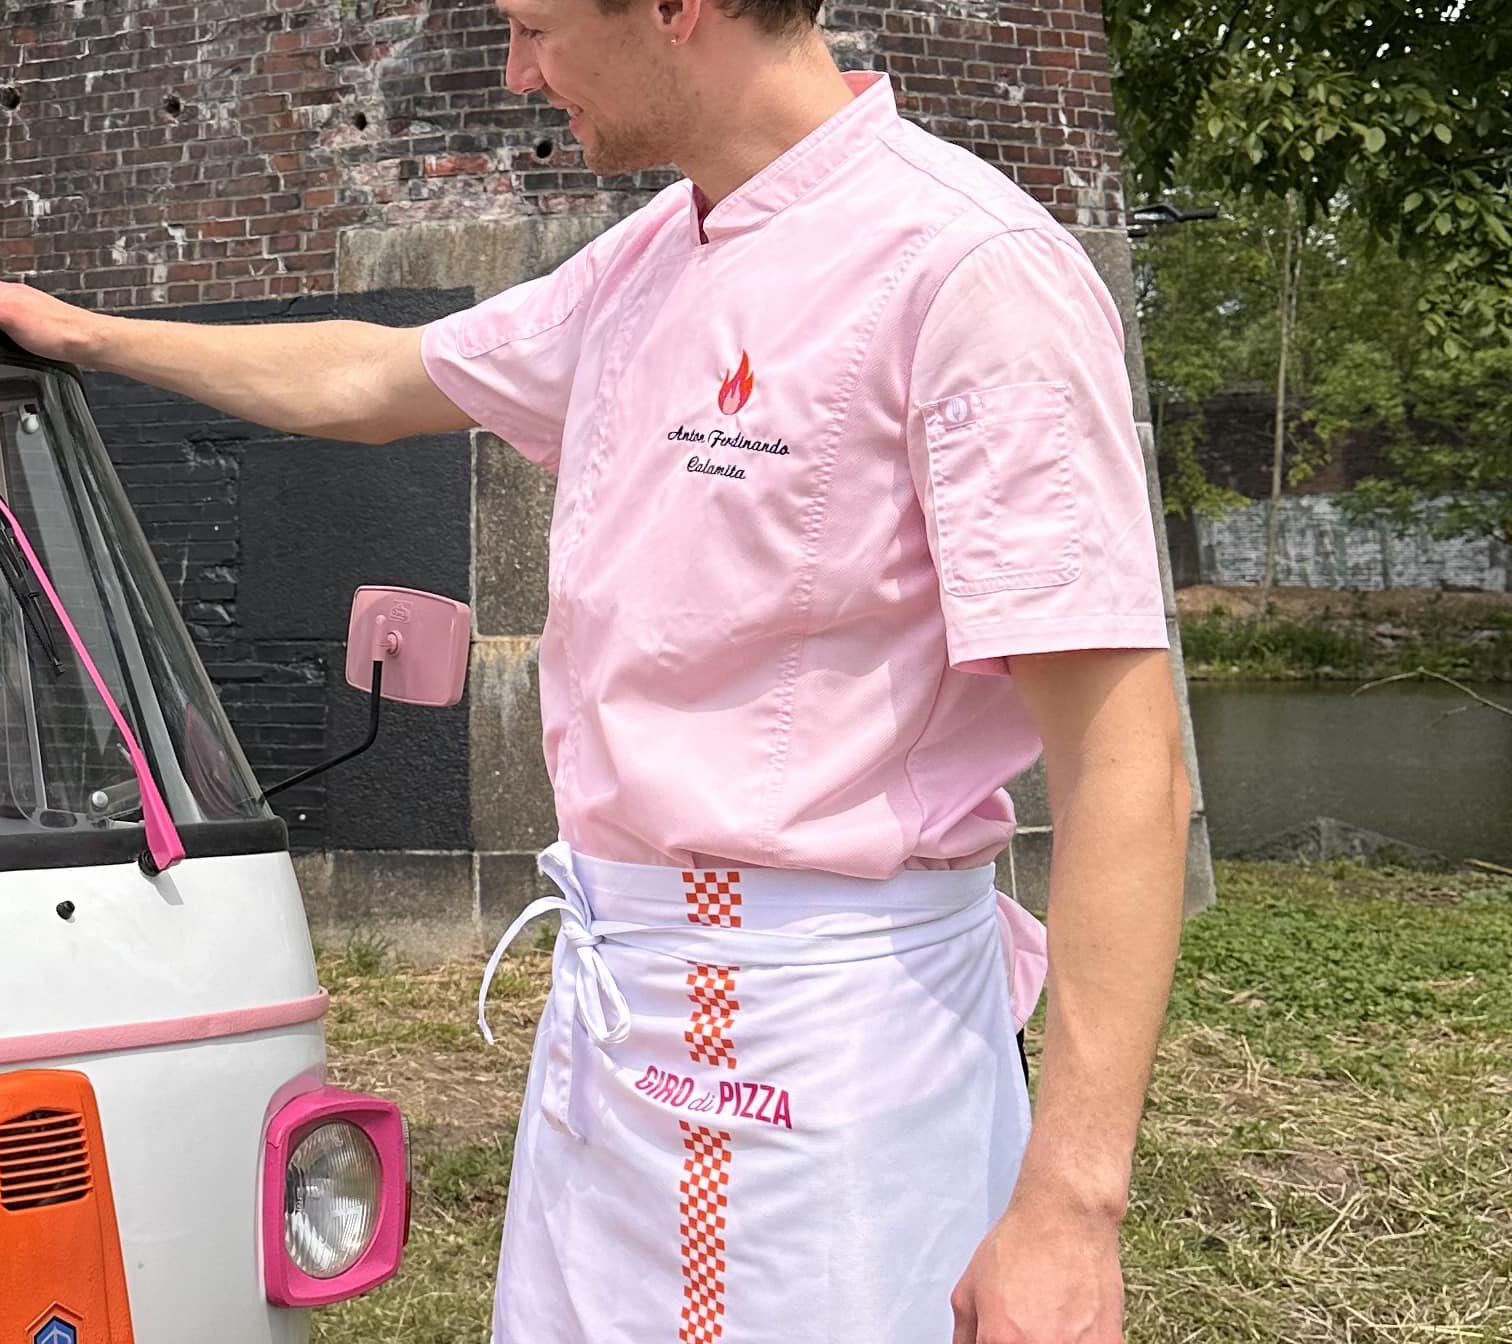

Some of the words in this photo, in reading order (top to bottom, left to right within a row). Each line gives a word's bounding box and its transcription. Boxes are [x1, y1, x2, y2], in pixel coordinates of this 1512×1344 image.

[634, 1065, 694, 1107] GIRO
[688, 1092, 716, 1112] di
[715, 1081, 793, 1129] PIZZA
